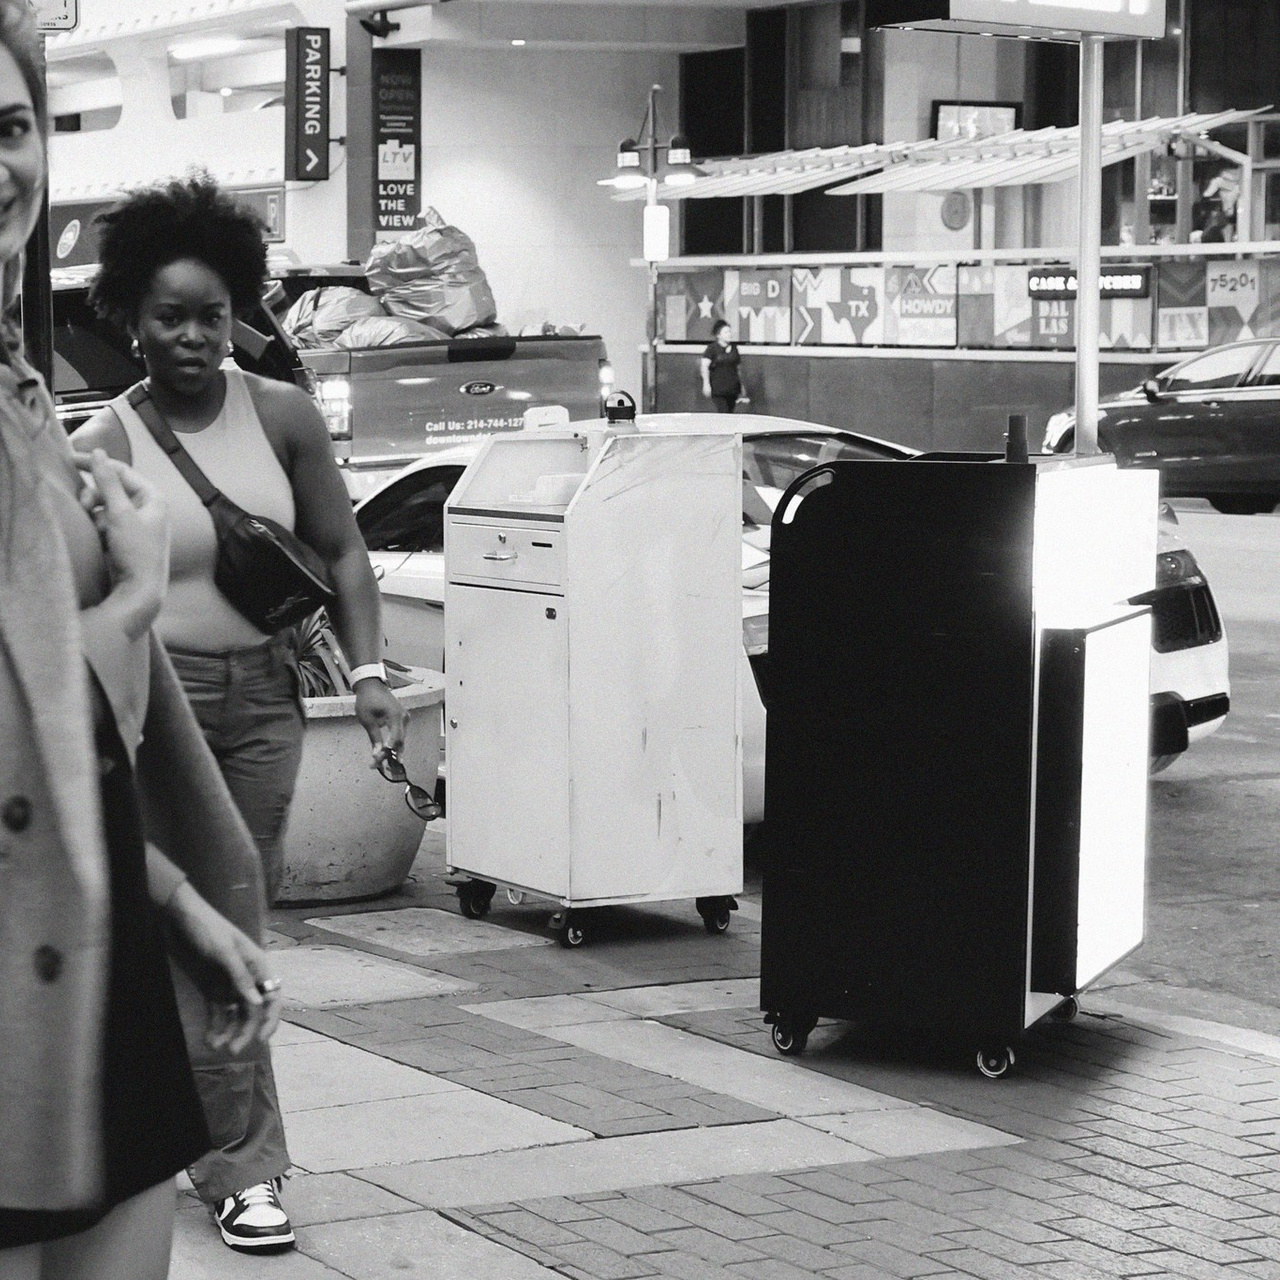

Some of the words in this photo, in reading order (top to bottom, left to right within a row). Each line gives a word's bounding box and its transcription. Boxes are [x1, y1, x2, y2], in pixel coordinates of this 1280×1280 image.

[305, 34, 321, 135] PARKING
[382, 151, 413, 163] LTV
[379, 184, 414, 195] LOVE
[379, 200, 405, 211] THE
[379, 215, 414, 227] VIEW
[740, 281, 761, 296] BIG
[767, 280, 780, 298] D
[1210, 273, 1256, 292] 75201
[848, 300, 870, 318] TX
[901, 299, 955, 315] HOWDY
[1039, 300, 1069, 317] DAL
[1039, 317, 1069, 335] LAS
[1162, 313, 1204, 341] TX
[469, 383, 491, 394] Ford
[425, 421, 445, 431] Call
[447, 421, 465, 430] Us:
[466, 418, 524, 430] 214-744-127
[425, 432, 488, 445] downtownd
